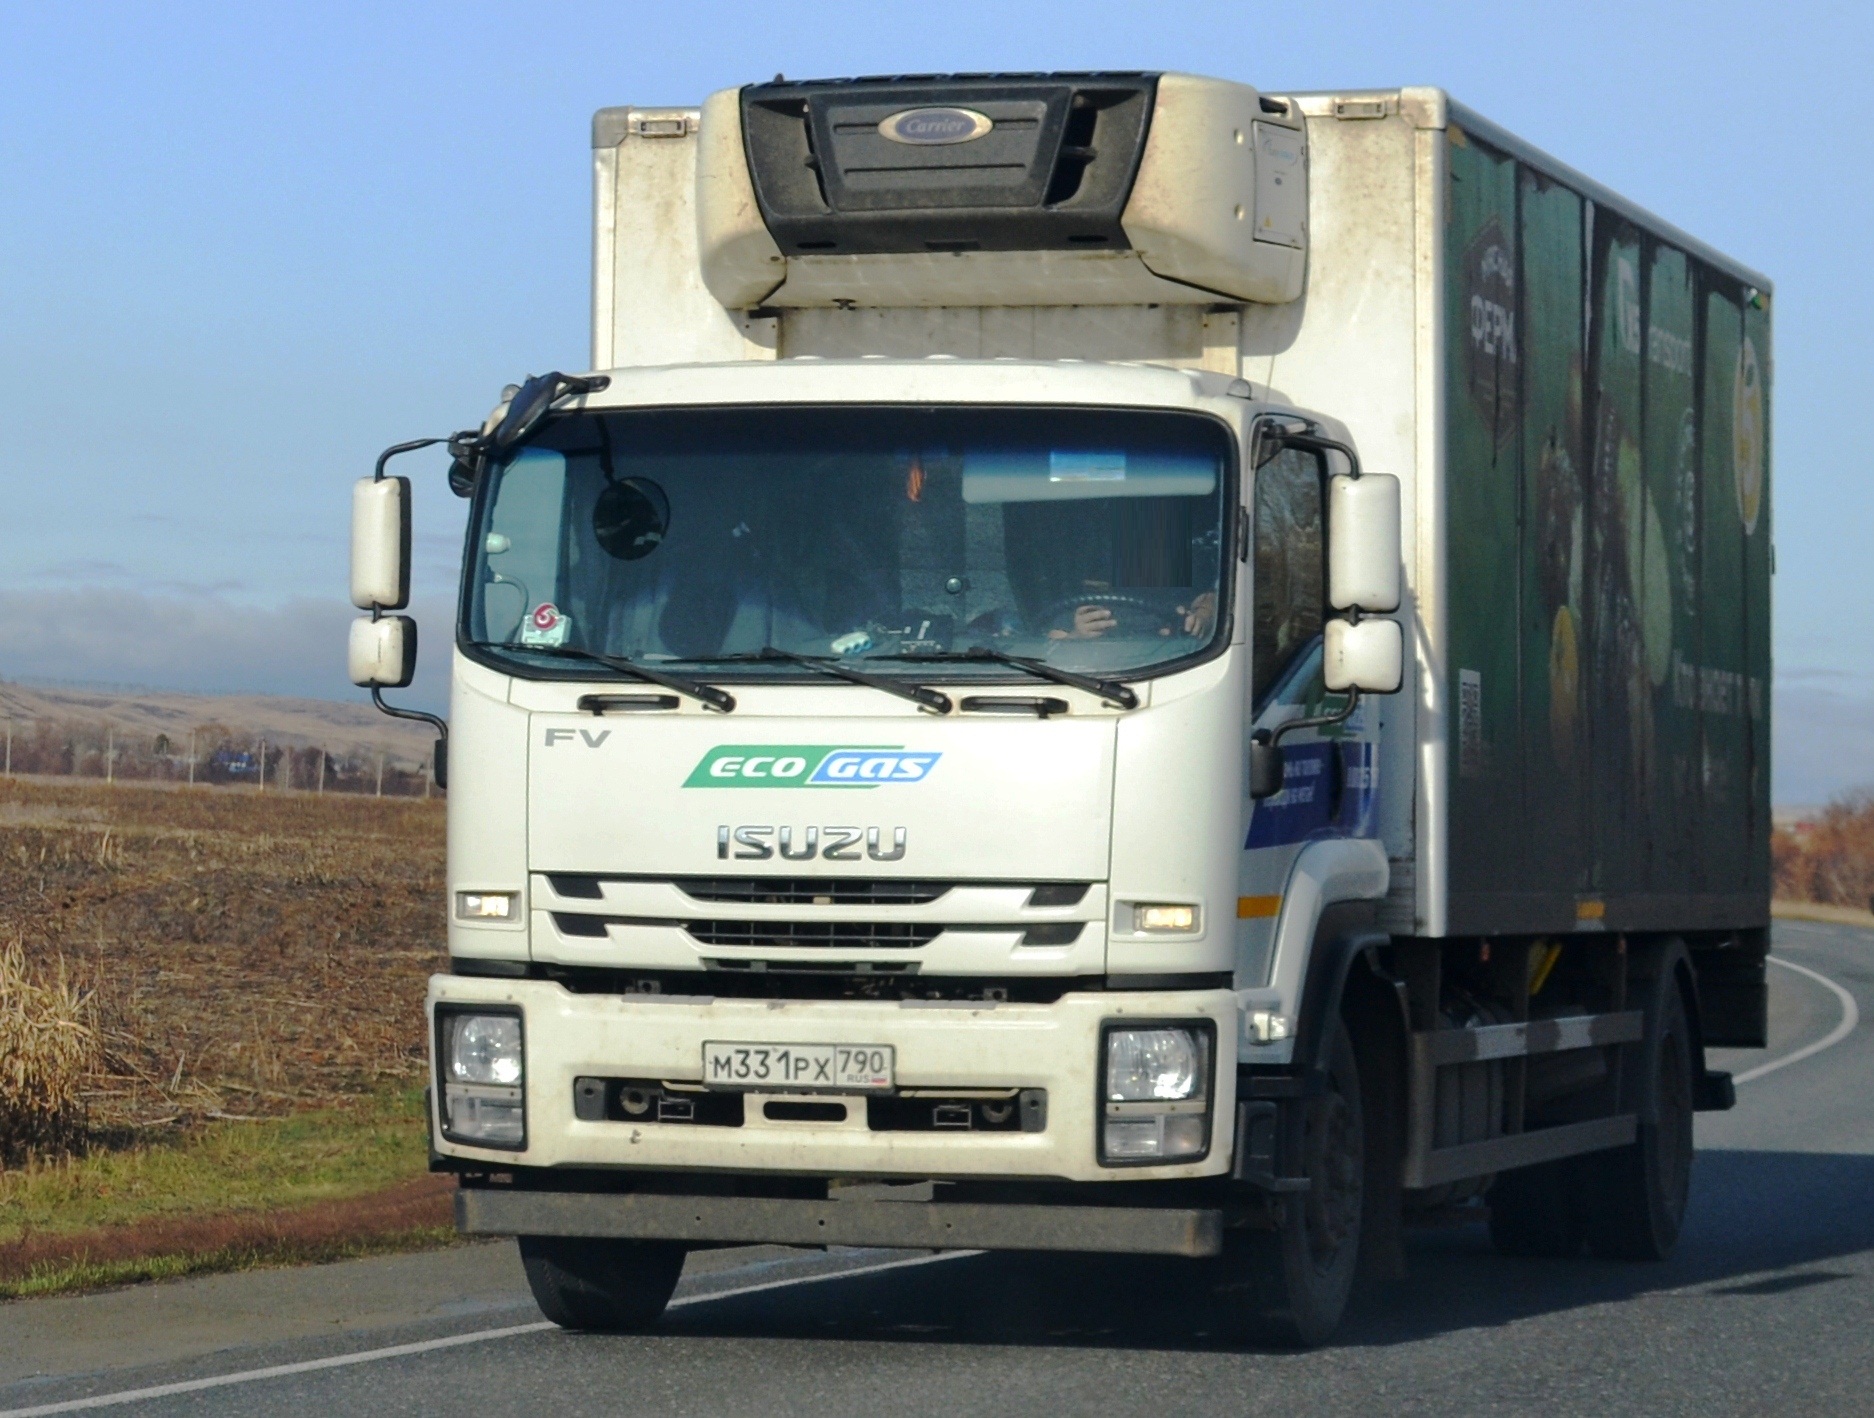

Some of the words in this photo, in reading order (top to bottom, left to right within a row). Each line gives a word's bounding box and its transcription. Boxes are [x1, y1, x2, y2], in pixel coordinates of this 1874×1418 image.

[906, 119, 965, 133] Carrier
[544, 728, 612, 749] FV
[709, 756, 806, 778] ECO
[716, 824, 908, 861] ISUZU
[838, 1050, 884, 1074] 790
[846, 1074, 869, 1084] RUS
